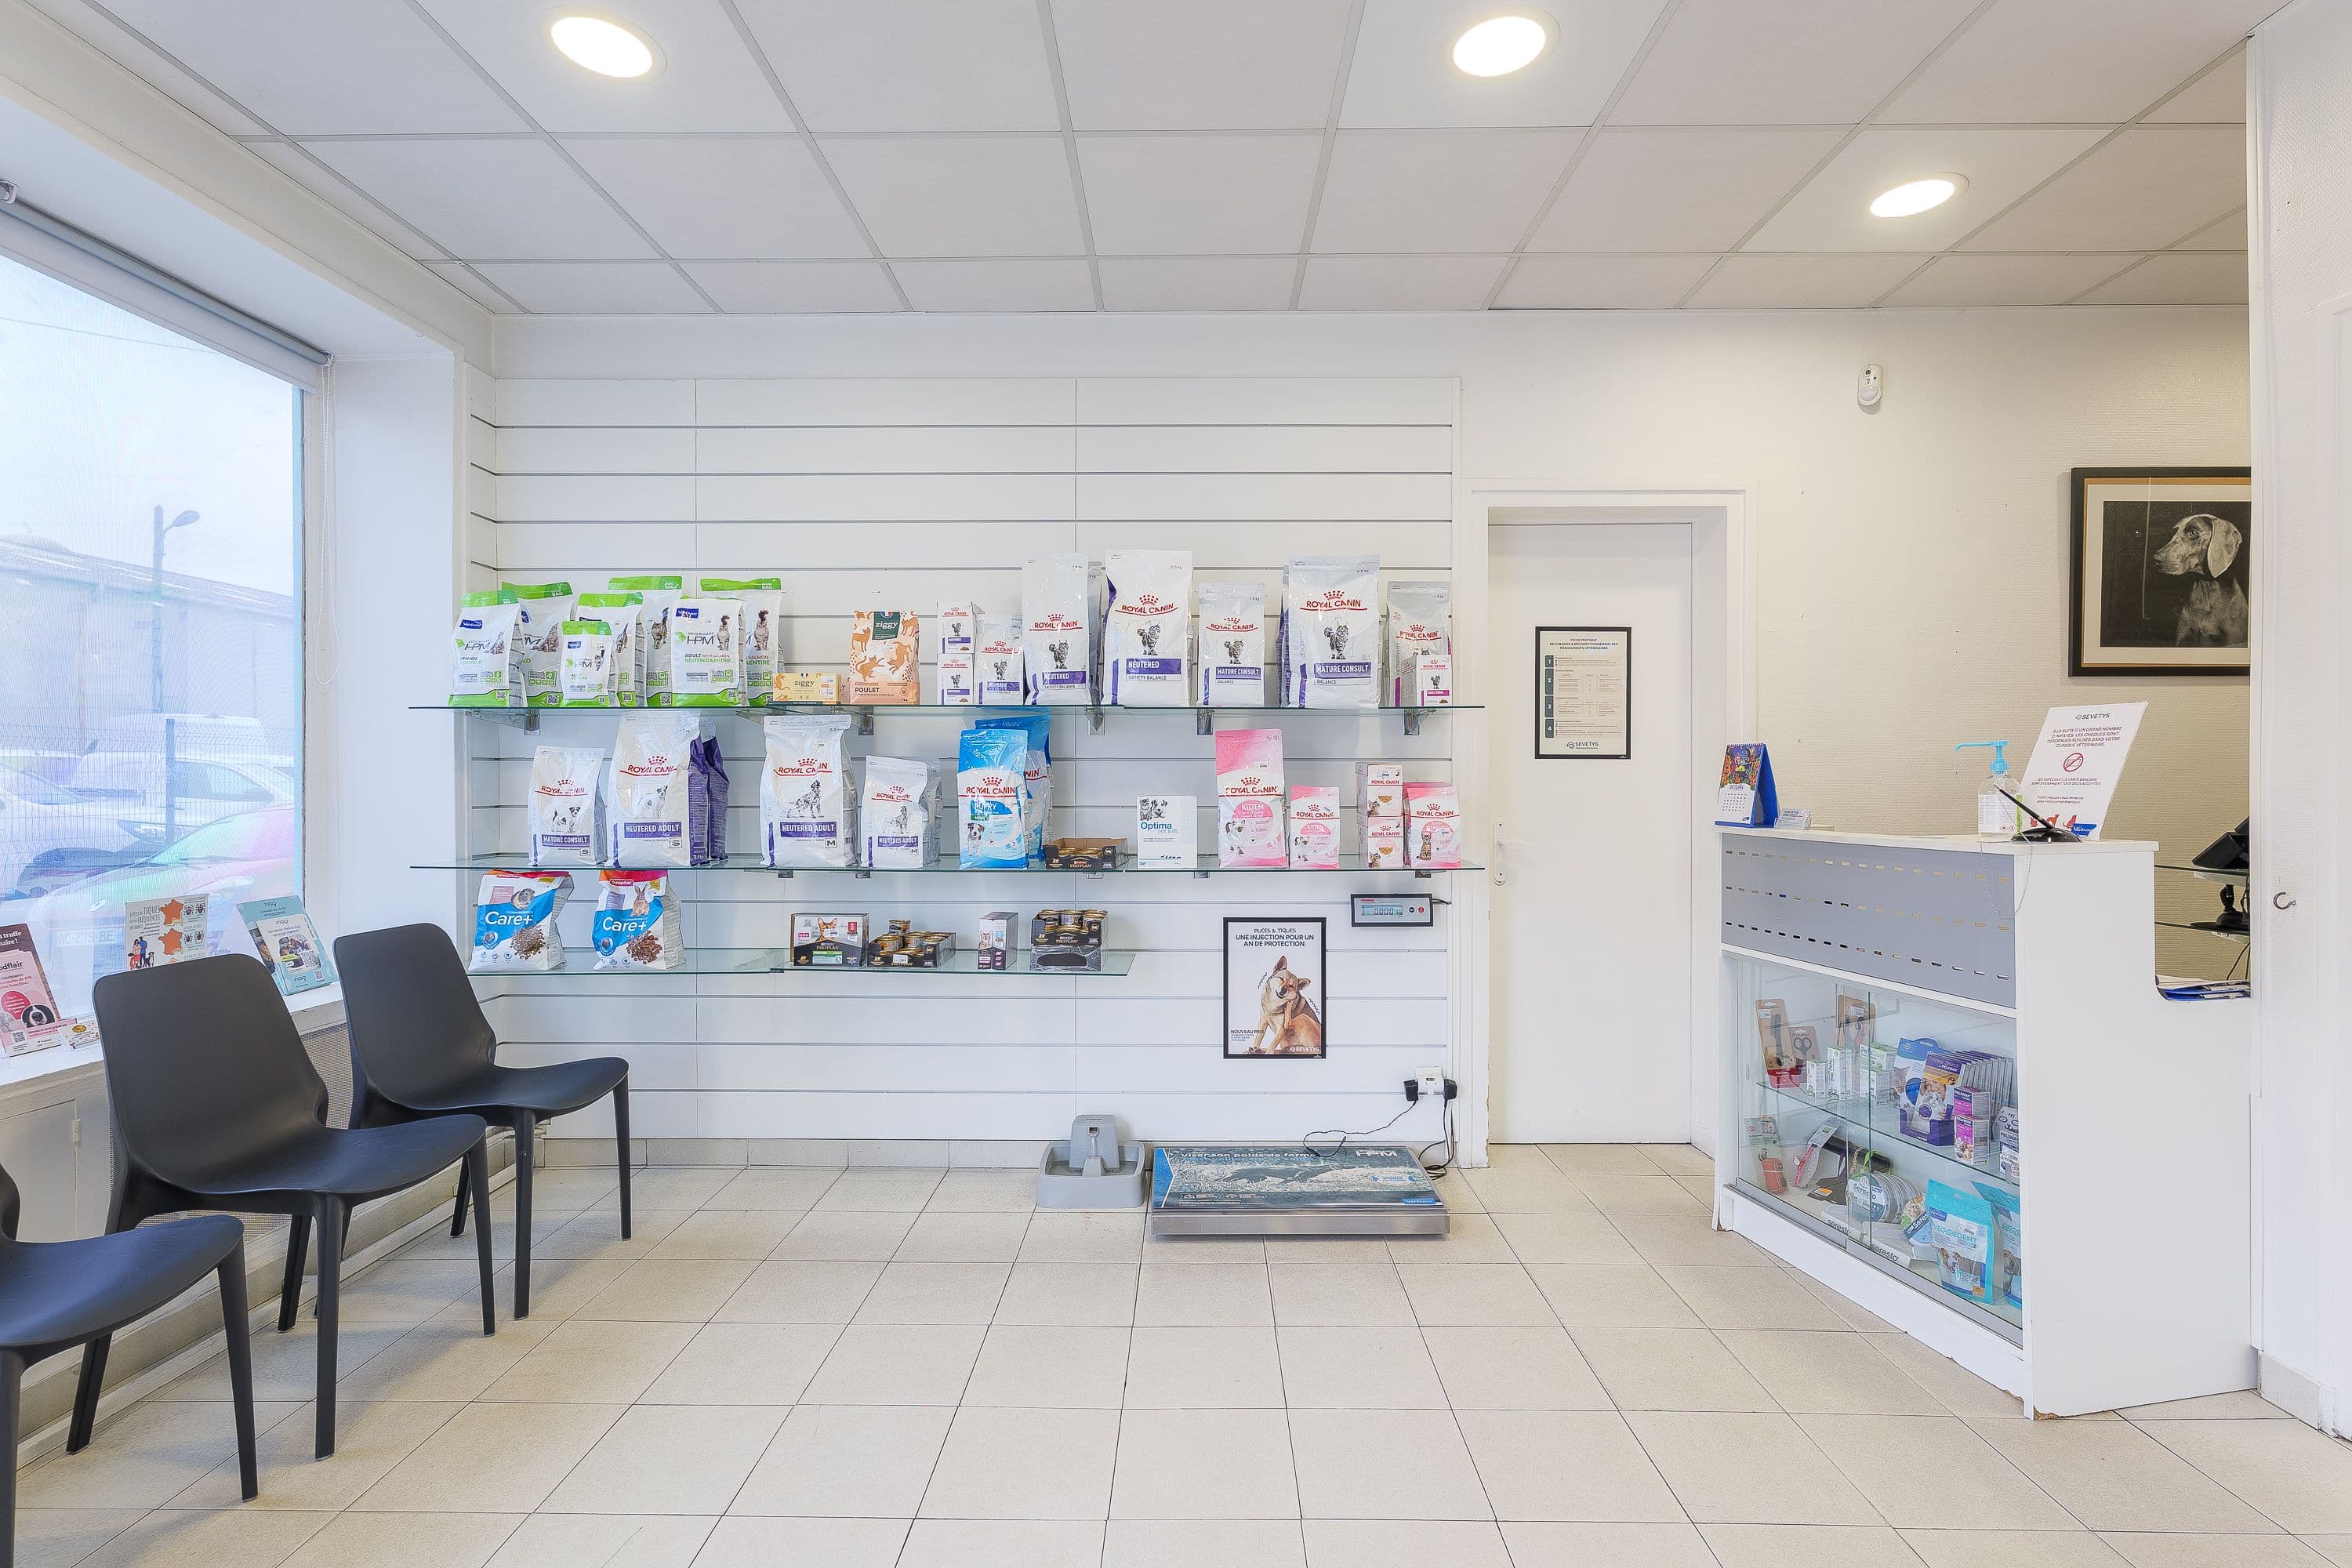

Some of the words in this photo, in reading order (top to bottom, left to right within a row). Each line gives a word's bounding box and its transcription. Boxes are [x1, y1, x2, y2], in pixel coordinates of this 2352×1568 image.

[1121, 604, 1147, 614] ROYAL
[1149, 604, 1174, 613] CANIN
[687, 636, 714, 644] HPM
[1316, 664, 1341, 673] MATURE
[1341, 664, 1369, 673] CONSULT
[1241, 802, 1264, 811] KITTEN
[1141, 822, 1172, 831] Optima
[143, 905, 161, 915] TIQUES
[485, 911, 533, 925] Care+
[602, 916, 647, 932] Care+
[2, 930, 22, 938] truffe
